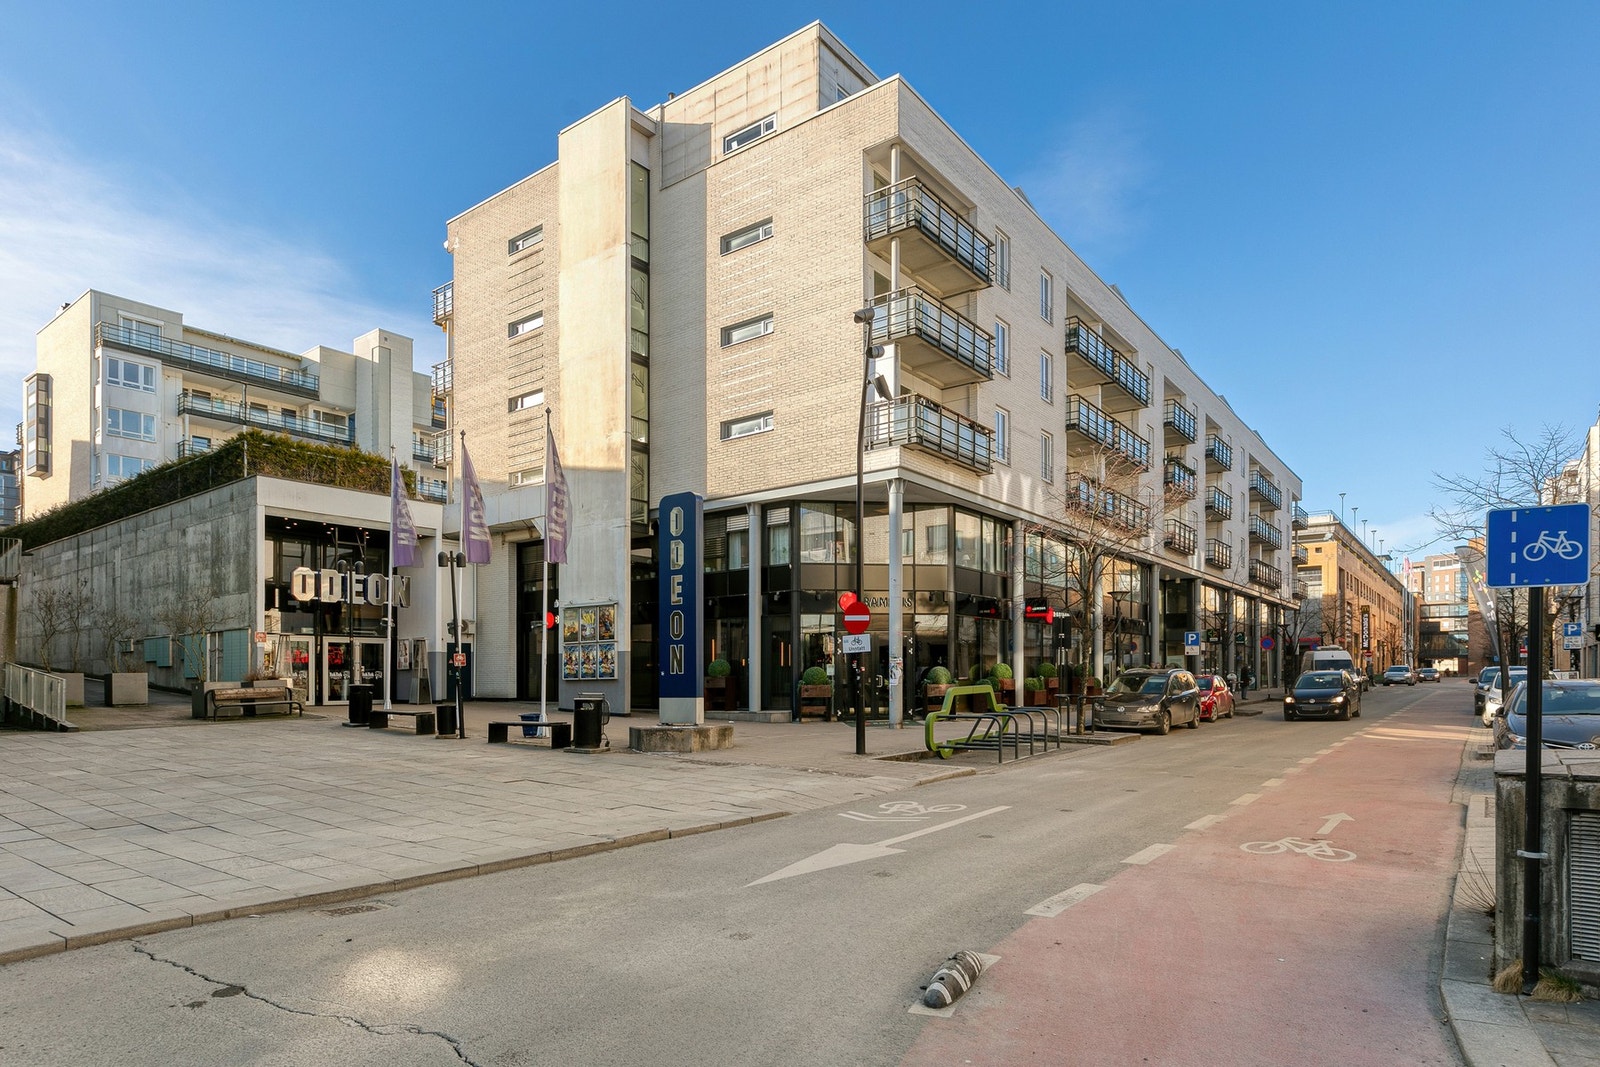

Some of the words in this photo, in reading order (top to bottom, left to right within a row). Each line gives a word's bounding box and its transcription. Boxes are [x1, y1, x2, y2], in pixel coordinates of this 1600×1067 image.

[290, 566, 412, 608] ODEON
[670, 506, 685, 675] ODEON
[1188, 633, 1197, 645] P
[1567, 624, 1578, 635] P
